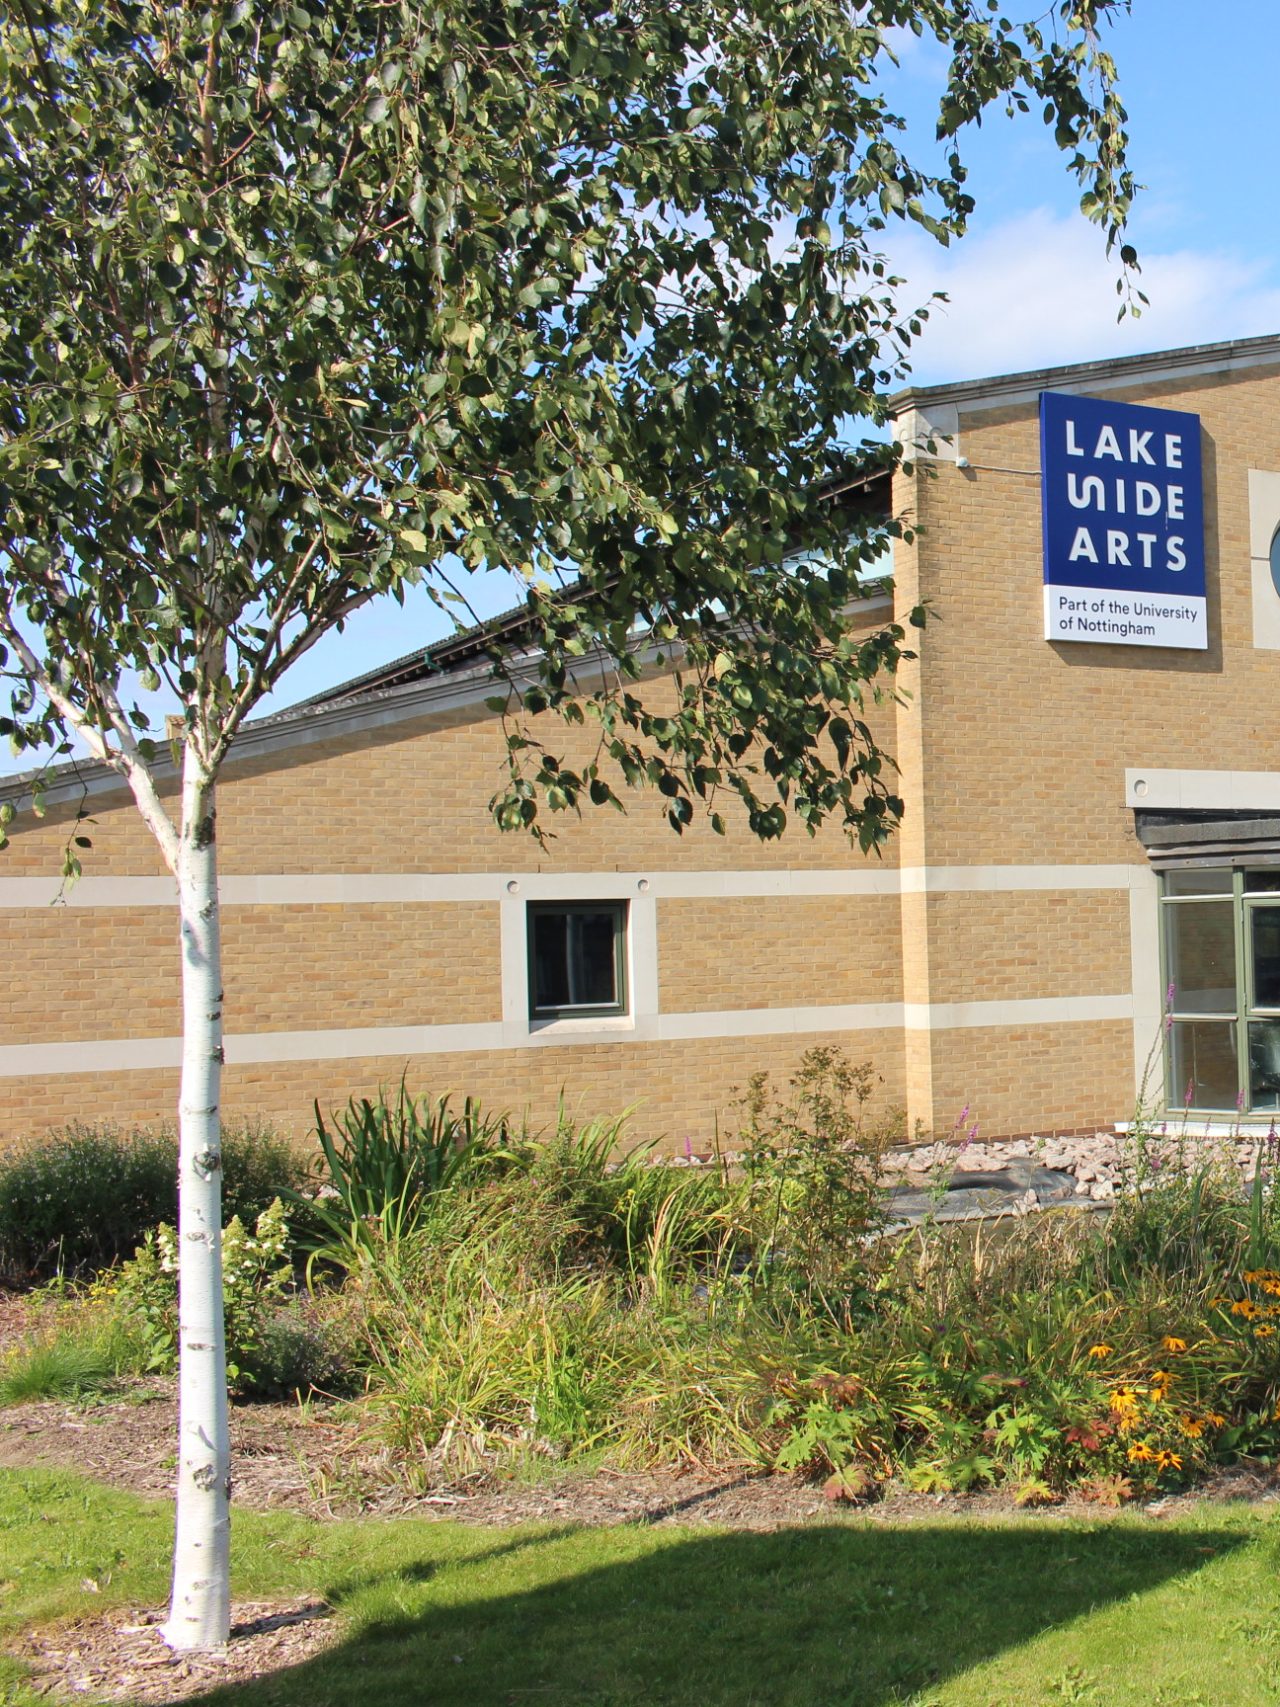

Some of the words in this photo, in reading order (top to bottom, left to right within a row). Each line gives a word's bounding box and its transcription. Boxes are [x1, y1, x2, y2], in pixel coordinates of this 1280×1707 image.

[1065, 420, 1183, 469] LAKE
[1068, 526, 1187, 572] ARTS
[1059, 596, 1087, 612] Part
[1092, 599, 1105, 613] of
[1108, 600, 1130, 615] the
[1134, 602, 1197, 623] University
[1059, 616, 1073, 630] of
[1077, 617, 1155, 637] Nottingham
